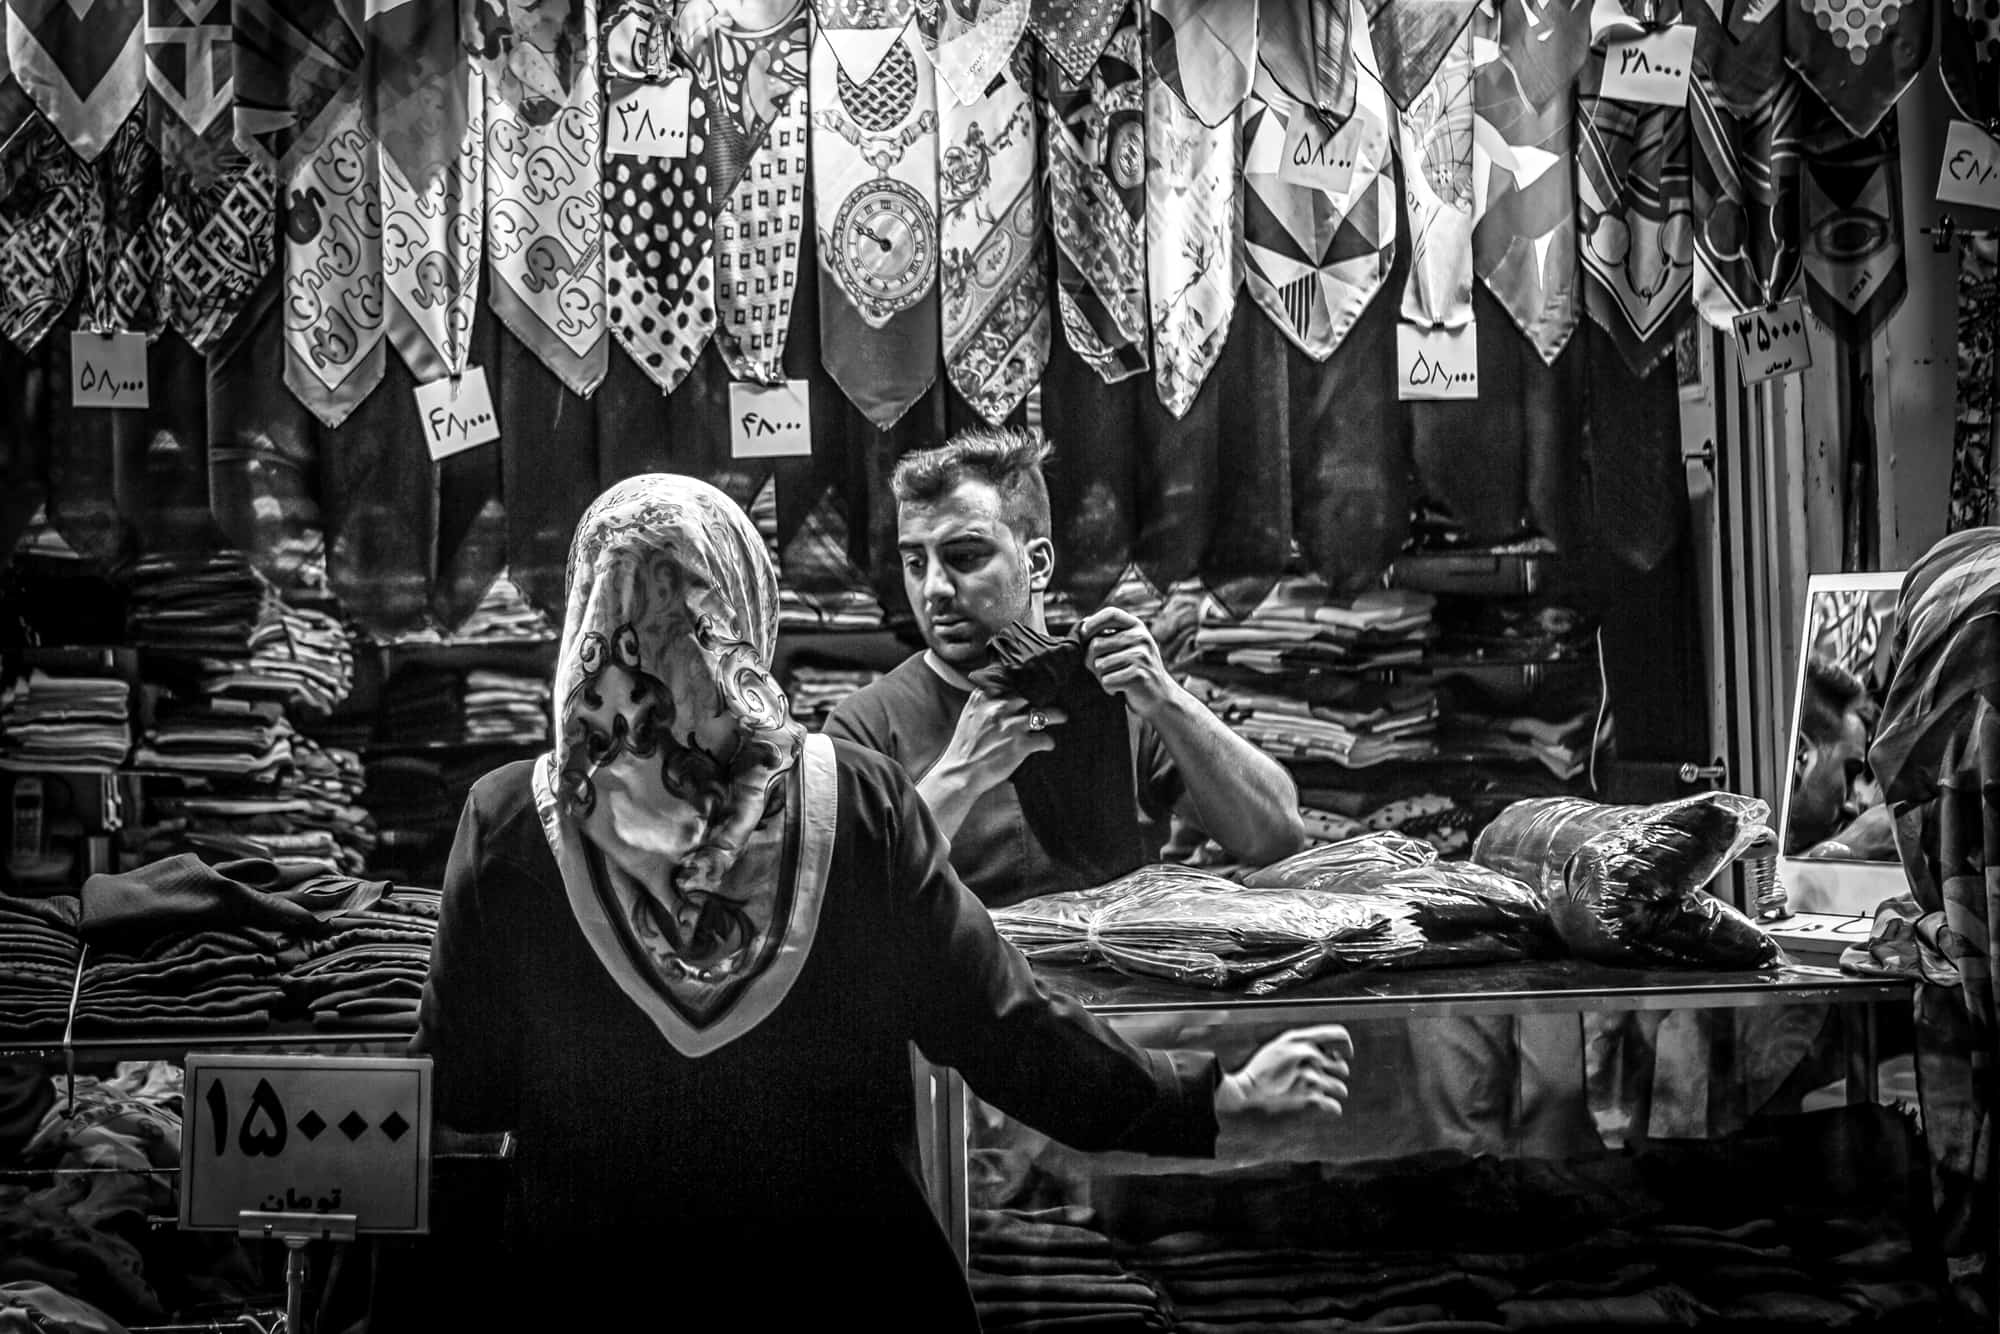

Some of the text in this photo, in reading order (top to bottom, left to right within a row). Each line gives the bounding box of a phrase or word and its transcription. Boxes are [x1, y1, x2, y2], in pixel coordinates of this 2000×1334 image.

[1739, 315, 1801, 355] ۳۵۰۰۰
[206, 1077, 410, 1157] ۱۵۰۰۰
[260, 1187, 342, 1213] تومان
